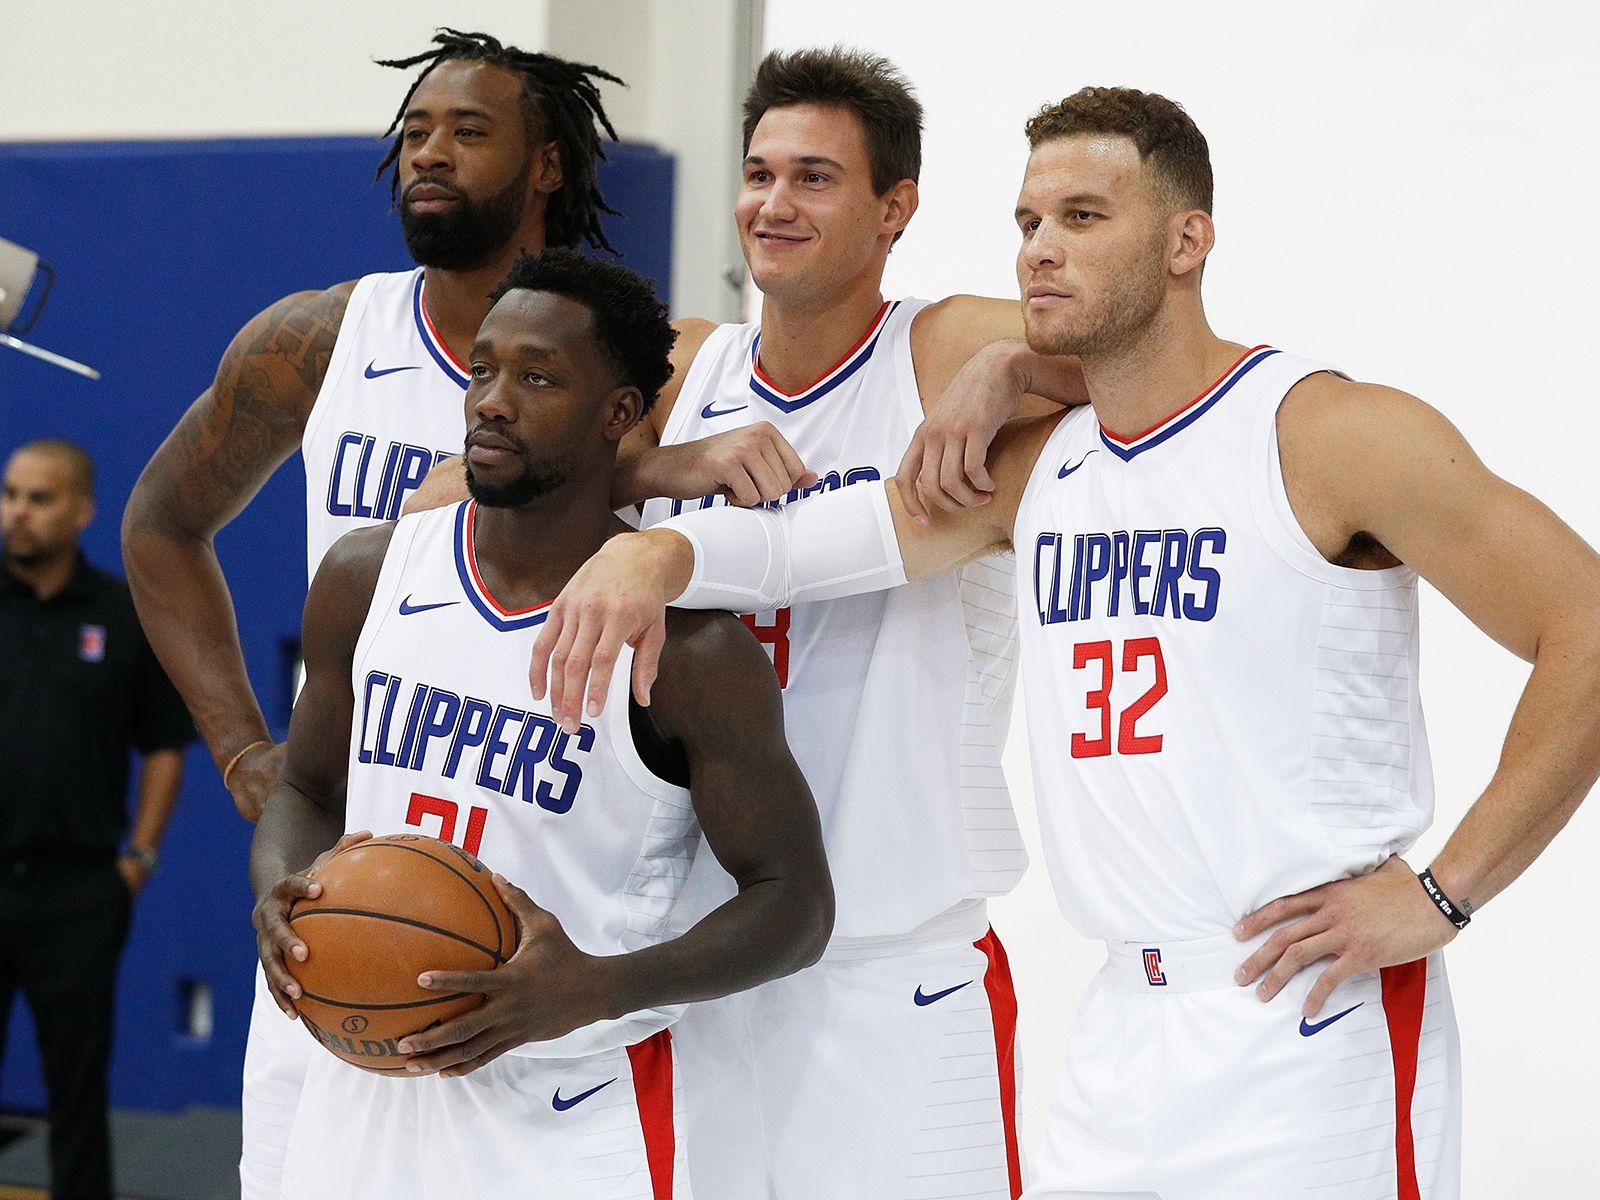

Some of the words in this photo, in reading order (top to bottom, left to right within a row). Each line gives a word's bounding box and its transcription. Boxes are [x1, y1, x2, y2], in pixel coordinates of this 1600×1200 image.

[326, 431, 460, 521] CLIP
[1033, 526, 1227, 627] CLIPPERS
[358, 669, 596, 815] CLIPPERS
[1071, 636, 1169, 759] 32
[1439, 900, 1453, 915] fin
